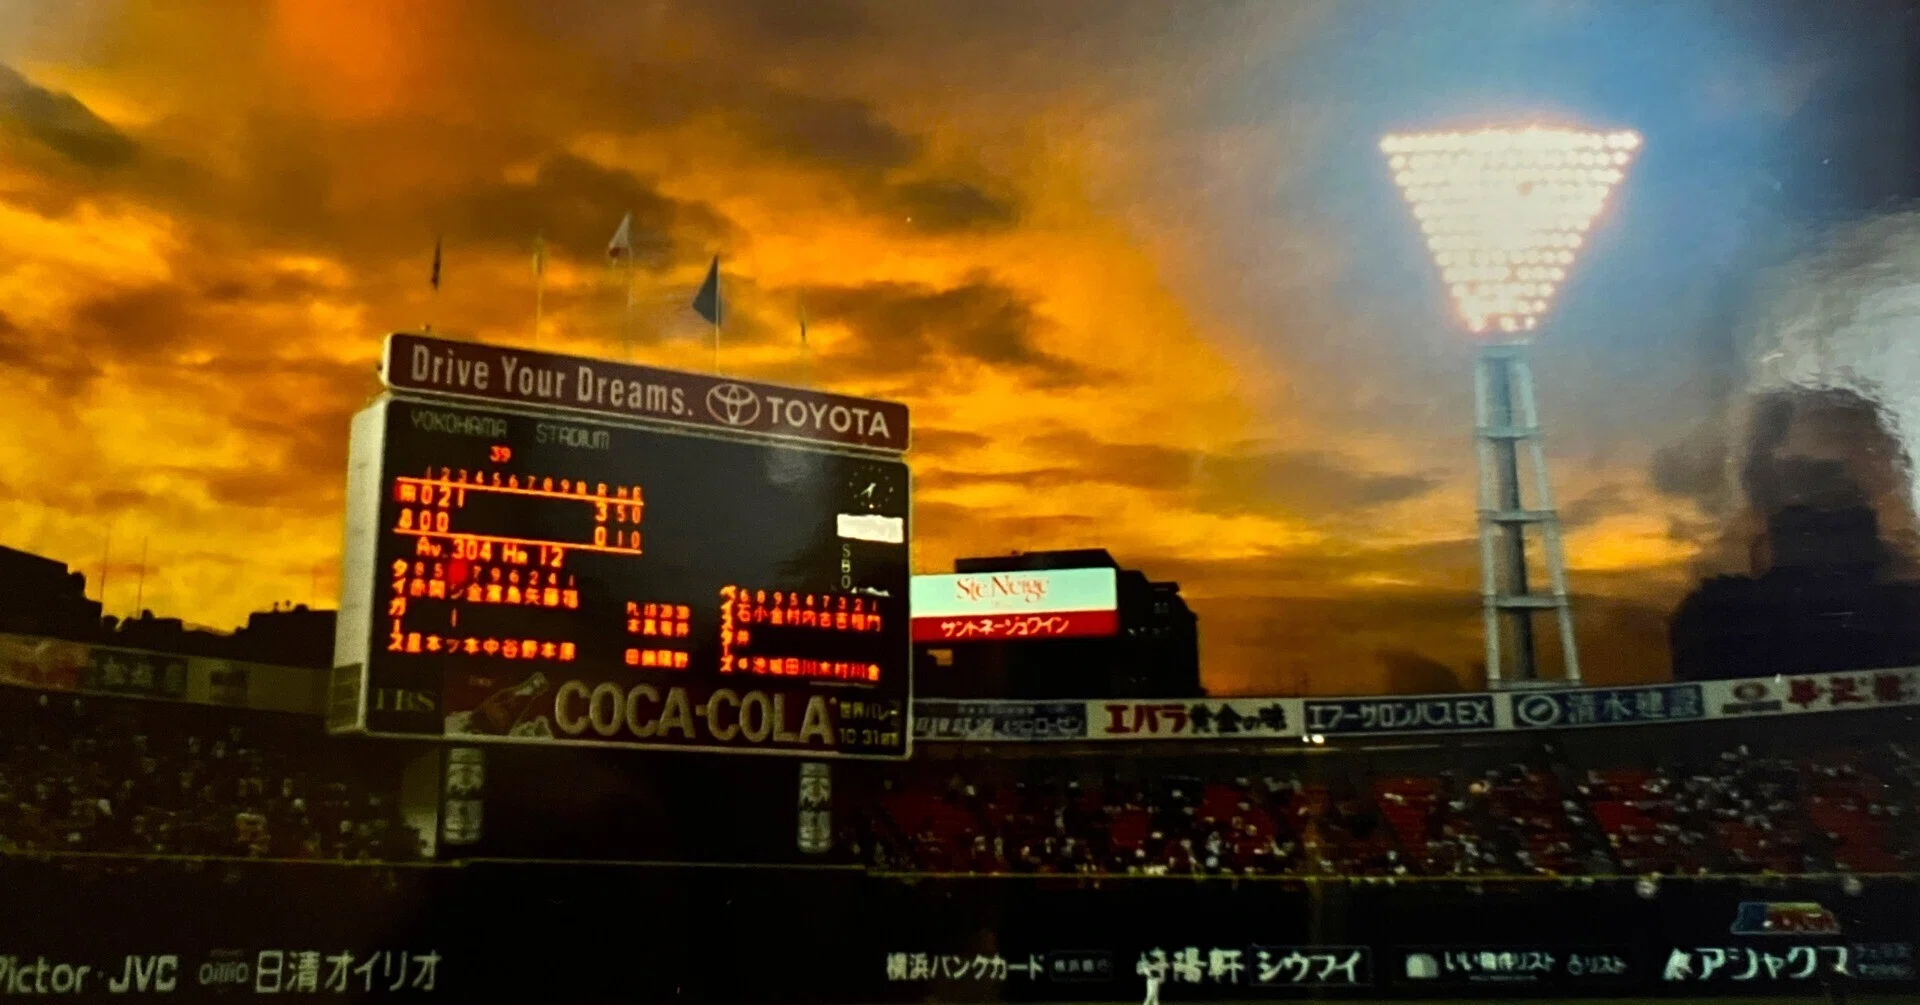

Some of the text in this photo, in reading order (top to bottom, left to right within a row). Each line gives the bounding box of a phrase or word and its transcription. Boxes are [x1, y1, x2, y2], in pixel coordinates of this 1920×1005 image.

[411, 345, 891, 439] Drive Your Dreams. TOYOTA
[411, 409, 609, 451] YOKOHAMA STADIUM
[842, 543, 851, 558] S
[1104, 703, 1187, 734] エバラ
[108, 954, 179, 994] JVC
[255, 948, 444, 994] 日清オイリオ
[886, 951, 1045, 983] 横浜バンクカード
[1256, 949, 1362, 984] シウマイ
